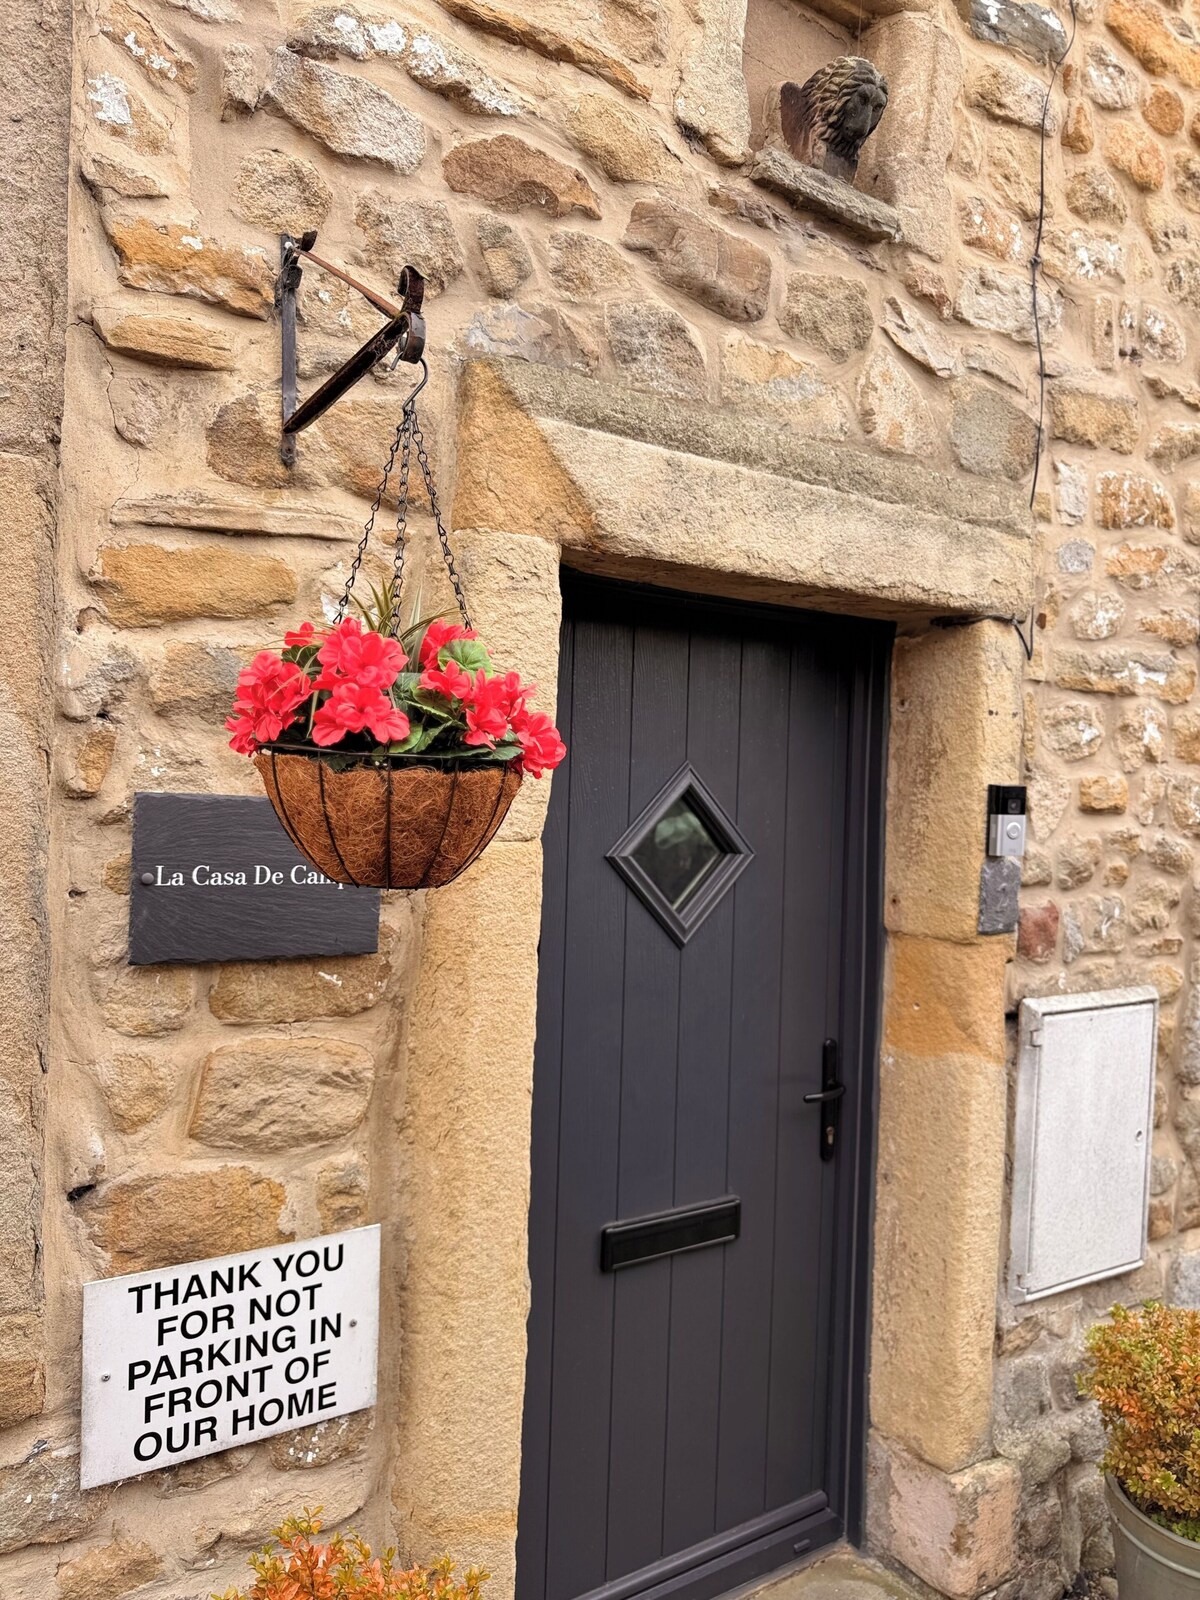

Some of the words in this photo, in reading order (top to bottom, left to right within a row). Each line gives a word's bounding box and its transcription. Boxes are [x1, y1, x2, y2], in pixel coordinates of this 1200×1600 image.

[154, 865, 185, 886] La
[191, 865, 248, 886] Casa
[253, 865, 284, 885] De
[290, 864, 345, 890] Ca
[128, 1261, 262, 1314] THANK
[272, 1243, 344, 1282] YOU
[157, 1303, 235, 1347] FOR
[249, 1283, 323, 1325] NOT
[128, 1325, 296, 1391] PARKING
[310, 1312, 342, 1345] IN
[144, 1364, 273, 1424] FRONT
[284, 1349, 331, 1385] OF
[133, 1416, 218, 1462] OUR
[232, 1381, 337, 1436] HOME
